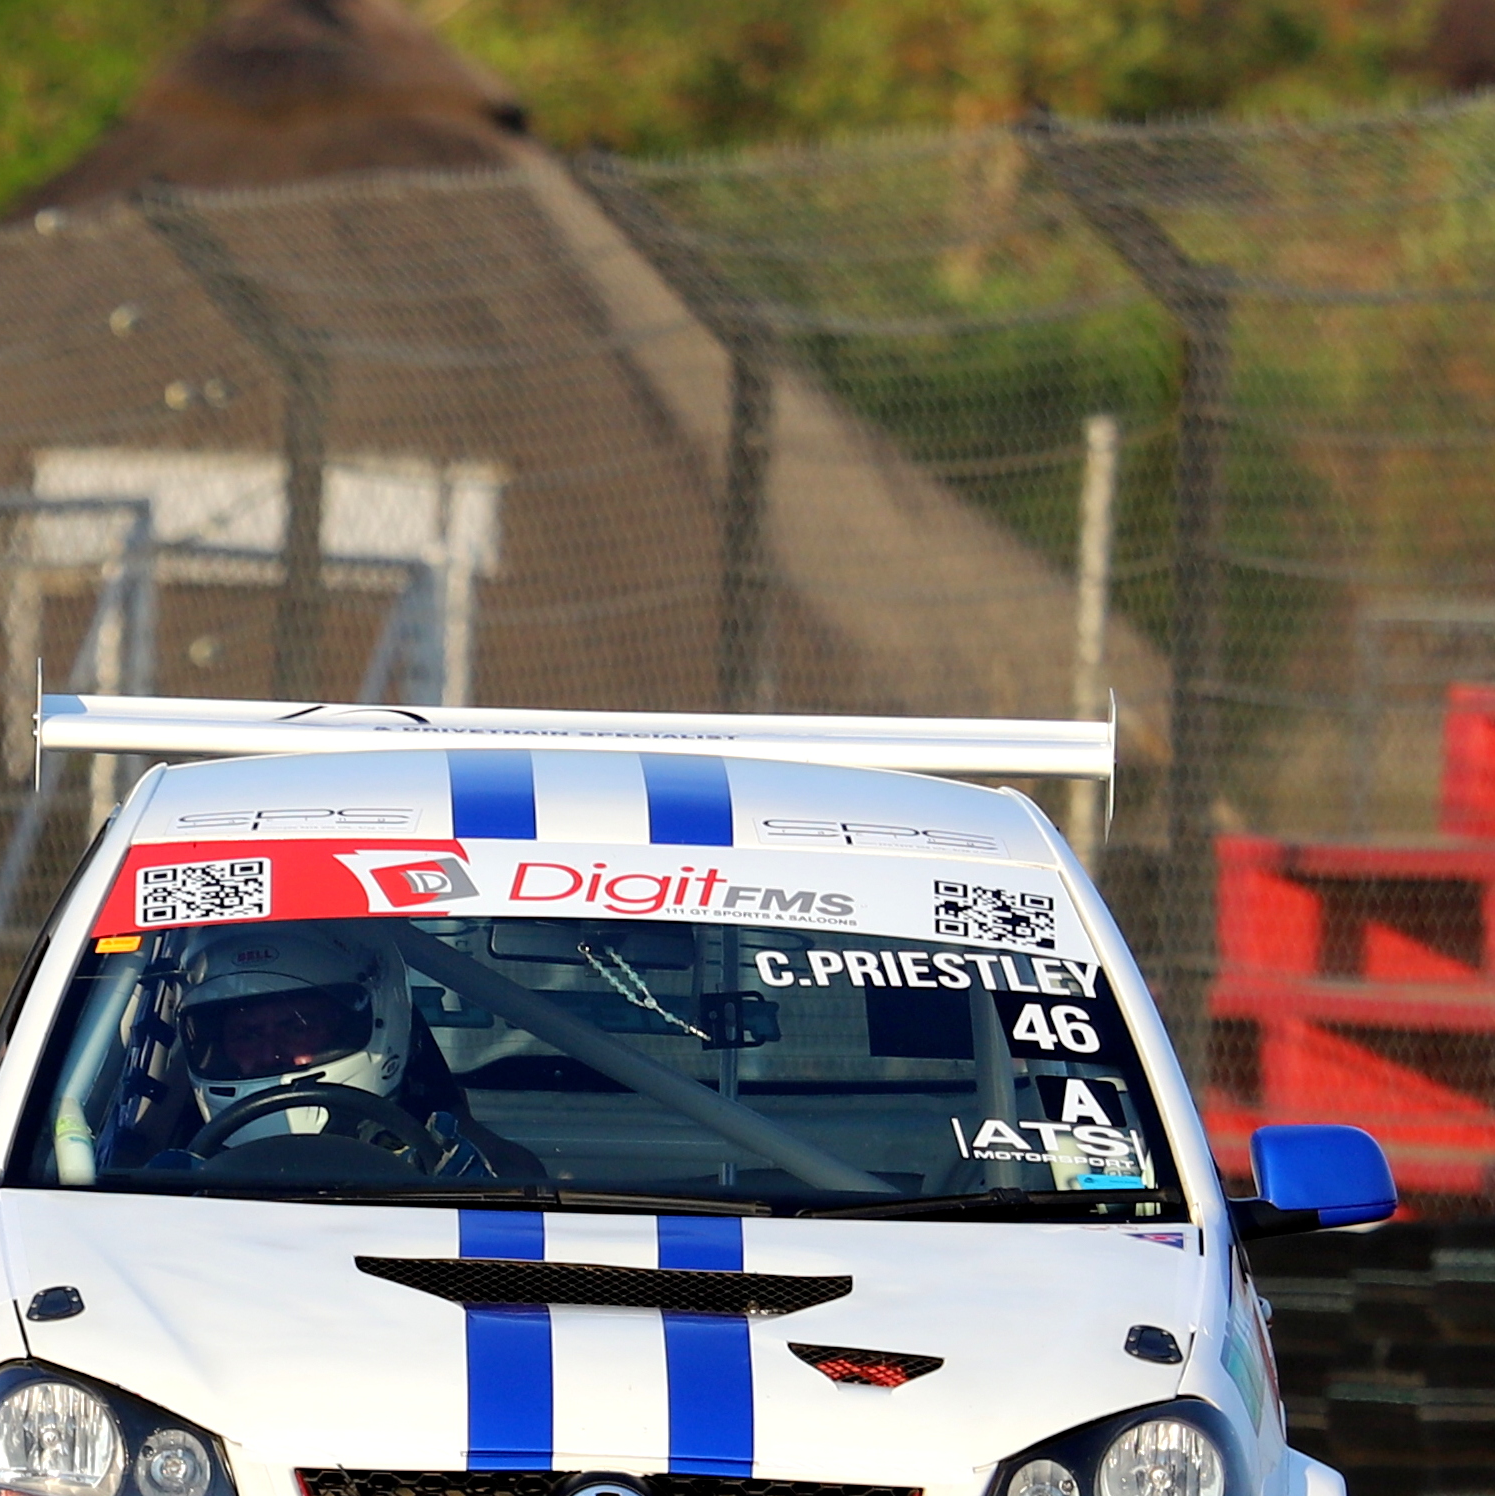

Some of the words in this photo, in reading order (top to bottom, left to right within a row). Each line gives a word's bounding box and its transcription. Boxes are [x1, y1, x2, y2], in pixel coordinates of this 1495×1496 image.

[402, 726, 568, 736] DRIVETRAIN
[579, 731, 738, 741] SPECIALIST
[509, 862, 855, 916] DigitFMS
[665, 907, 685, 915] 111
[690, 908, 710, 916] GT
[713, 909, 769, 920] SPORTS
[775, 914, 785, 922] &
[788, 914, 857, 927] SALOONS
[755, 950, 1098, 998] C.PRIESTLEY
[1012, 1003, 1100, 1053] 46
[1062, 1078, 1112, 1126] A
[972, 1118, 1131, 1158] ATS
[973, 1149, 1135, 1170] MOTORSPORT
